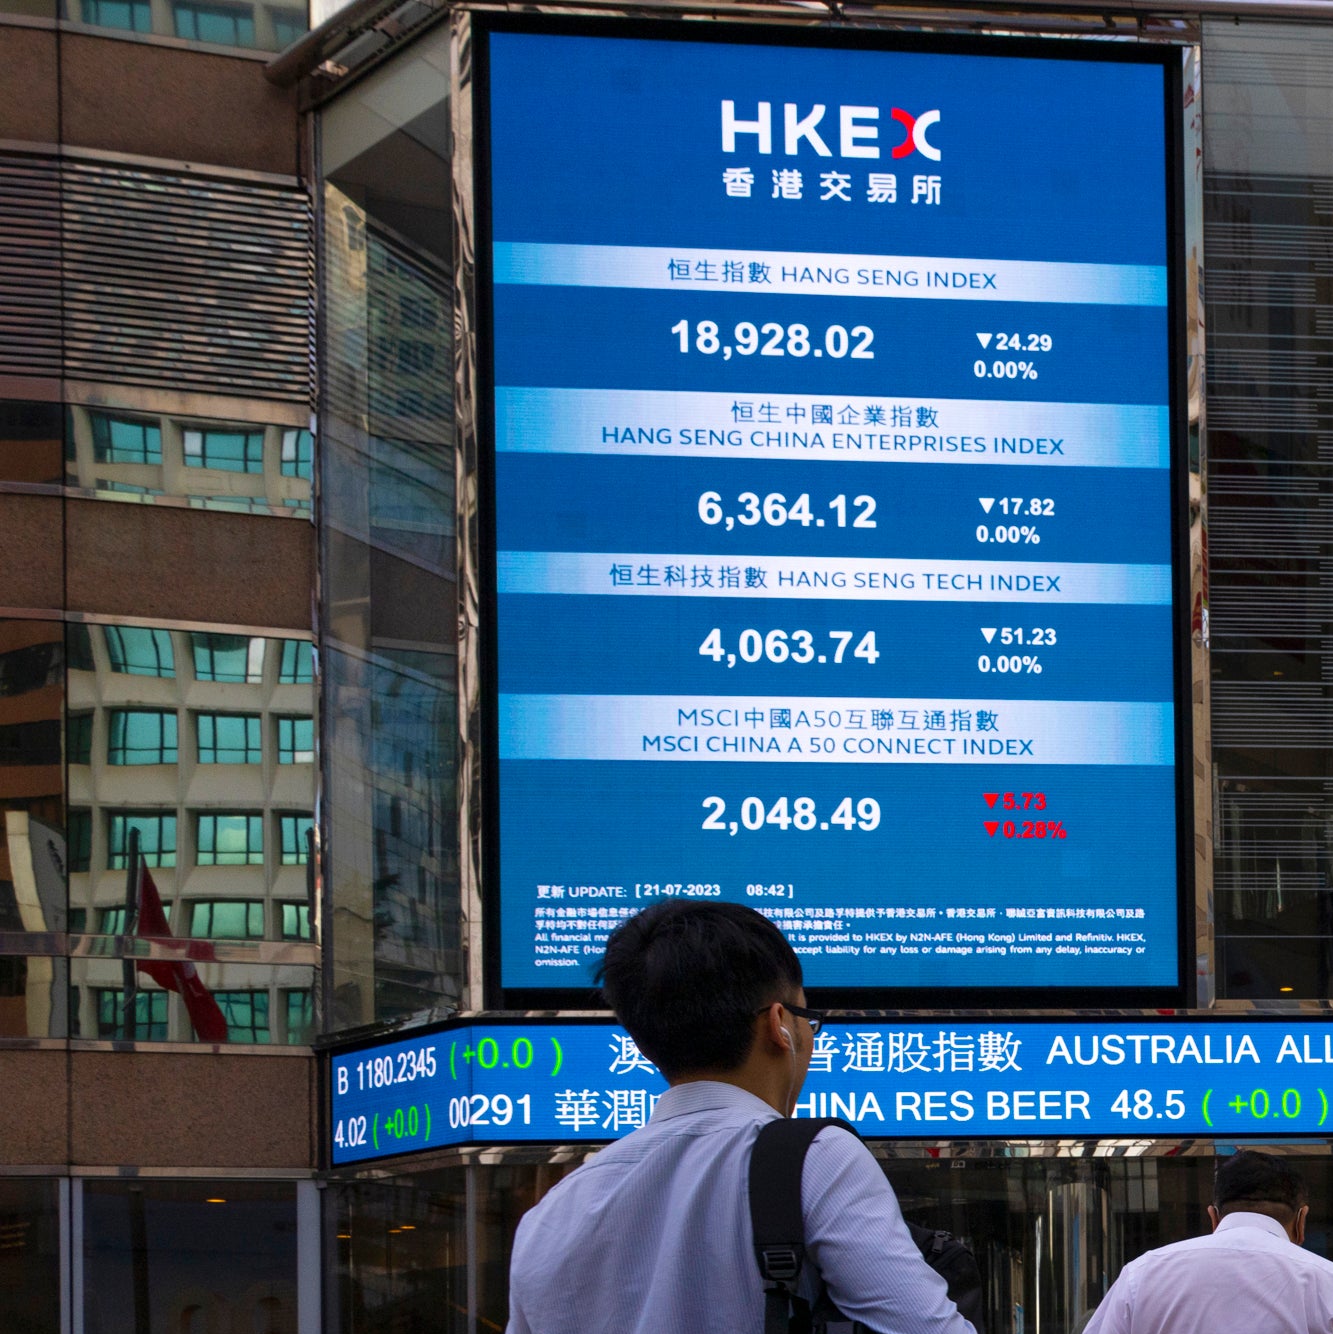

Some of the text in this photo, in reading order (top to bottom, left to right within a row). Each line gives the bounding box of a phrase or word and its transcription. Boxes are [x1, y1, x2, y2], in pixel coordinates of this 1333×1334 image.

[722, 100, 941, 161] HKEX
[723, 167, 941, 204] 香港交易所
[668, 258, 996, 289] 恒生指數 HANG SENG INDEX
[672, 320, 1052, 360] 18,928.02 24.29
[974, 360, 1037, 379] 0.00%
[731, 401, 938, 428] 恒生中國企業指數
[602, 426, 1064, 455] HANG SENG CHINA ENTERPRISES INDEX
[698, 492, 1054, 531] 6,364.12 17.82
[976, 525, 1040, 544] 0.00%
[608, 563, 1060, 592] 恒生科技指數 HANG SENG TECH INDEX
[699, 628, 1056, 668] 4,063.74 51.23
[978, 655, 1042, 673] 0.00%
[643, 736, 1033, 755] MSCI CHINA A 50 CONNECT INDEX
[702, 792, 1046, 836] 2,048.49 5.73
[1003, 821, 1067, 838] 0.28%
[538, 885, 564, 898] 更新
[569, 887, 626, 897] UPDATE:
[535, 933, 548, 941] All
[551, 933, 591, 941] financial
[535, 945, 579, 954] N2N-AFE
[809, 934, 849, 942] provided
[866, 933, 893, 941] HKEX
[896, 933, 907, 943] by
[910, 933, 952, 941] N2N-AFE
[956, 933, 984, 943] (Hong
[988, 933, 1015, 943] Kong)
[1019, 933, 1052, 941] Limited
[826, 945, 860, 955] liability
[880, 947, 897, 955] any
[900, 945, 918, 953] loss
[935, 946, 972, 955] damage
[976, 946, 1006, 955] arising
[1010, 945, 1032, 953] from
[1036, 947, 1052, 955] any
[1055, 946, 1081, 955] delay,
[1085, 946, 1132, 955] inaccuracy
[338, 1067, 348, 1094] B
[357, 1047, 436, 1090] 1180.2345
[608, 1033, 661, 1075] 澳
[807, 1031, 1023, 1073] 普通股指數
[1046, 1035, 1260, 1065] AUSTRALIA
[335, 1116, 366, 1147] 4.02
[449, 1094, 530, 1128] 00291
[554, 1089, 661, 1131] 華潤
[896, 1091, 974, 1121] RES
[987, 1091, 1090, 1120] BEER
[1111, 1089, 1185, 1119] 48.5
